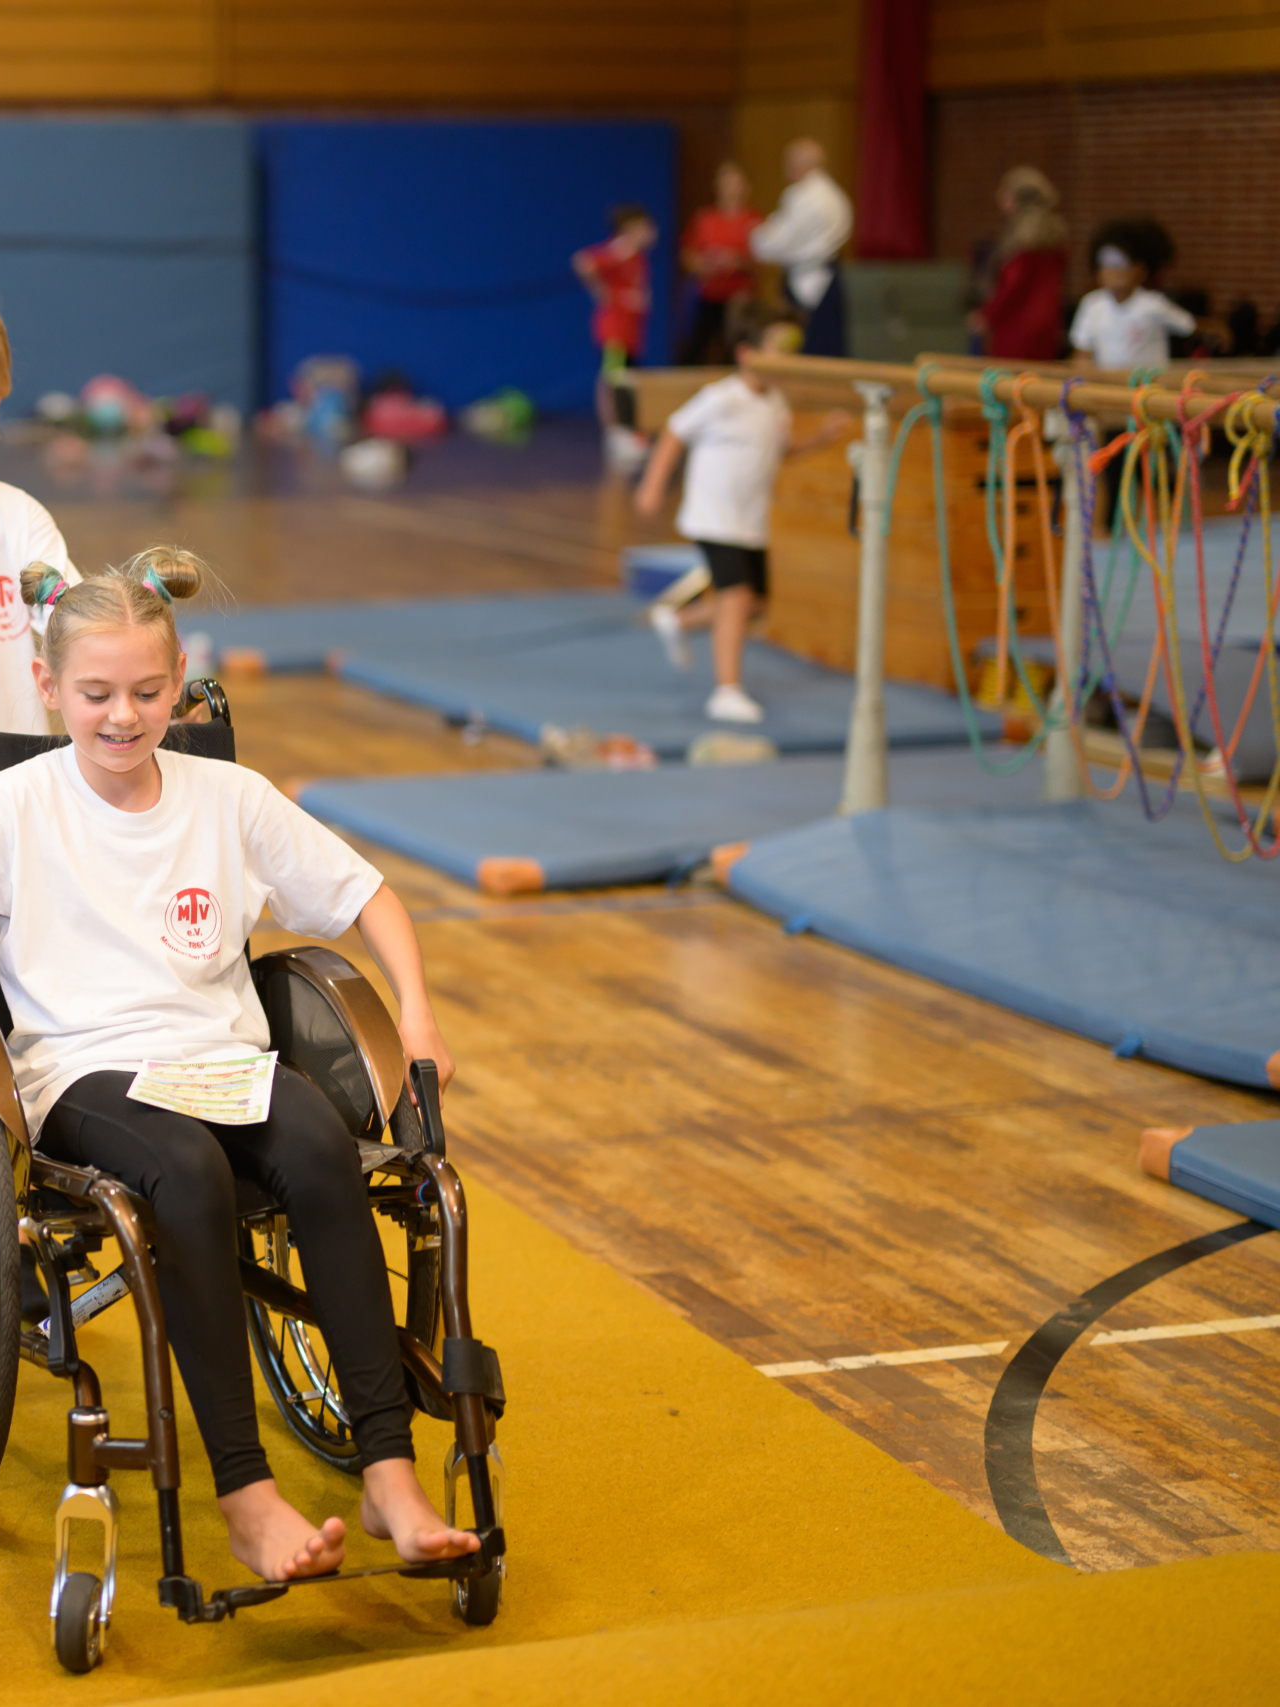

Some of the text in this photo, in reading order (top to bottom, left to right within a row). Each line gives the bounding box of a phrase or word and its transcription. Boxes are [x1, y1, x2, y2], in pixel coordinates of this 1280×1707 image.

[176, 887, 210, 925] MTV
[186, 927, 203, 937] e.V.
[188, 940, 206, 950] 1861
